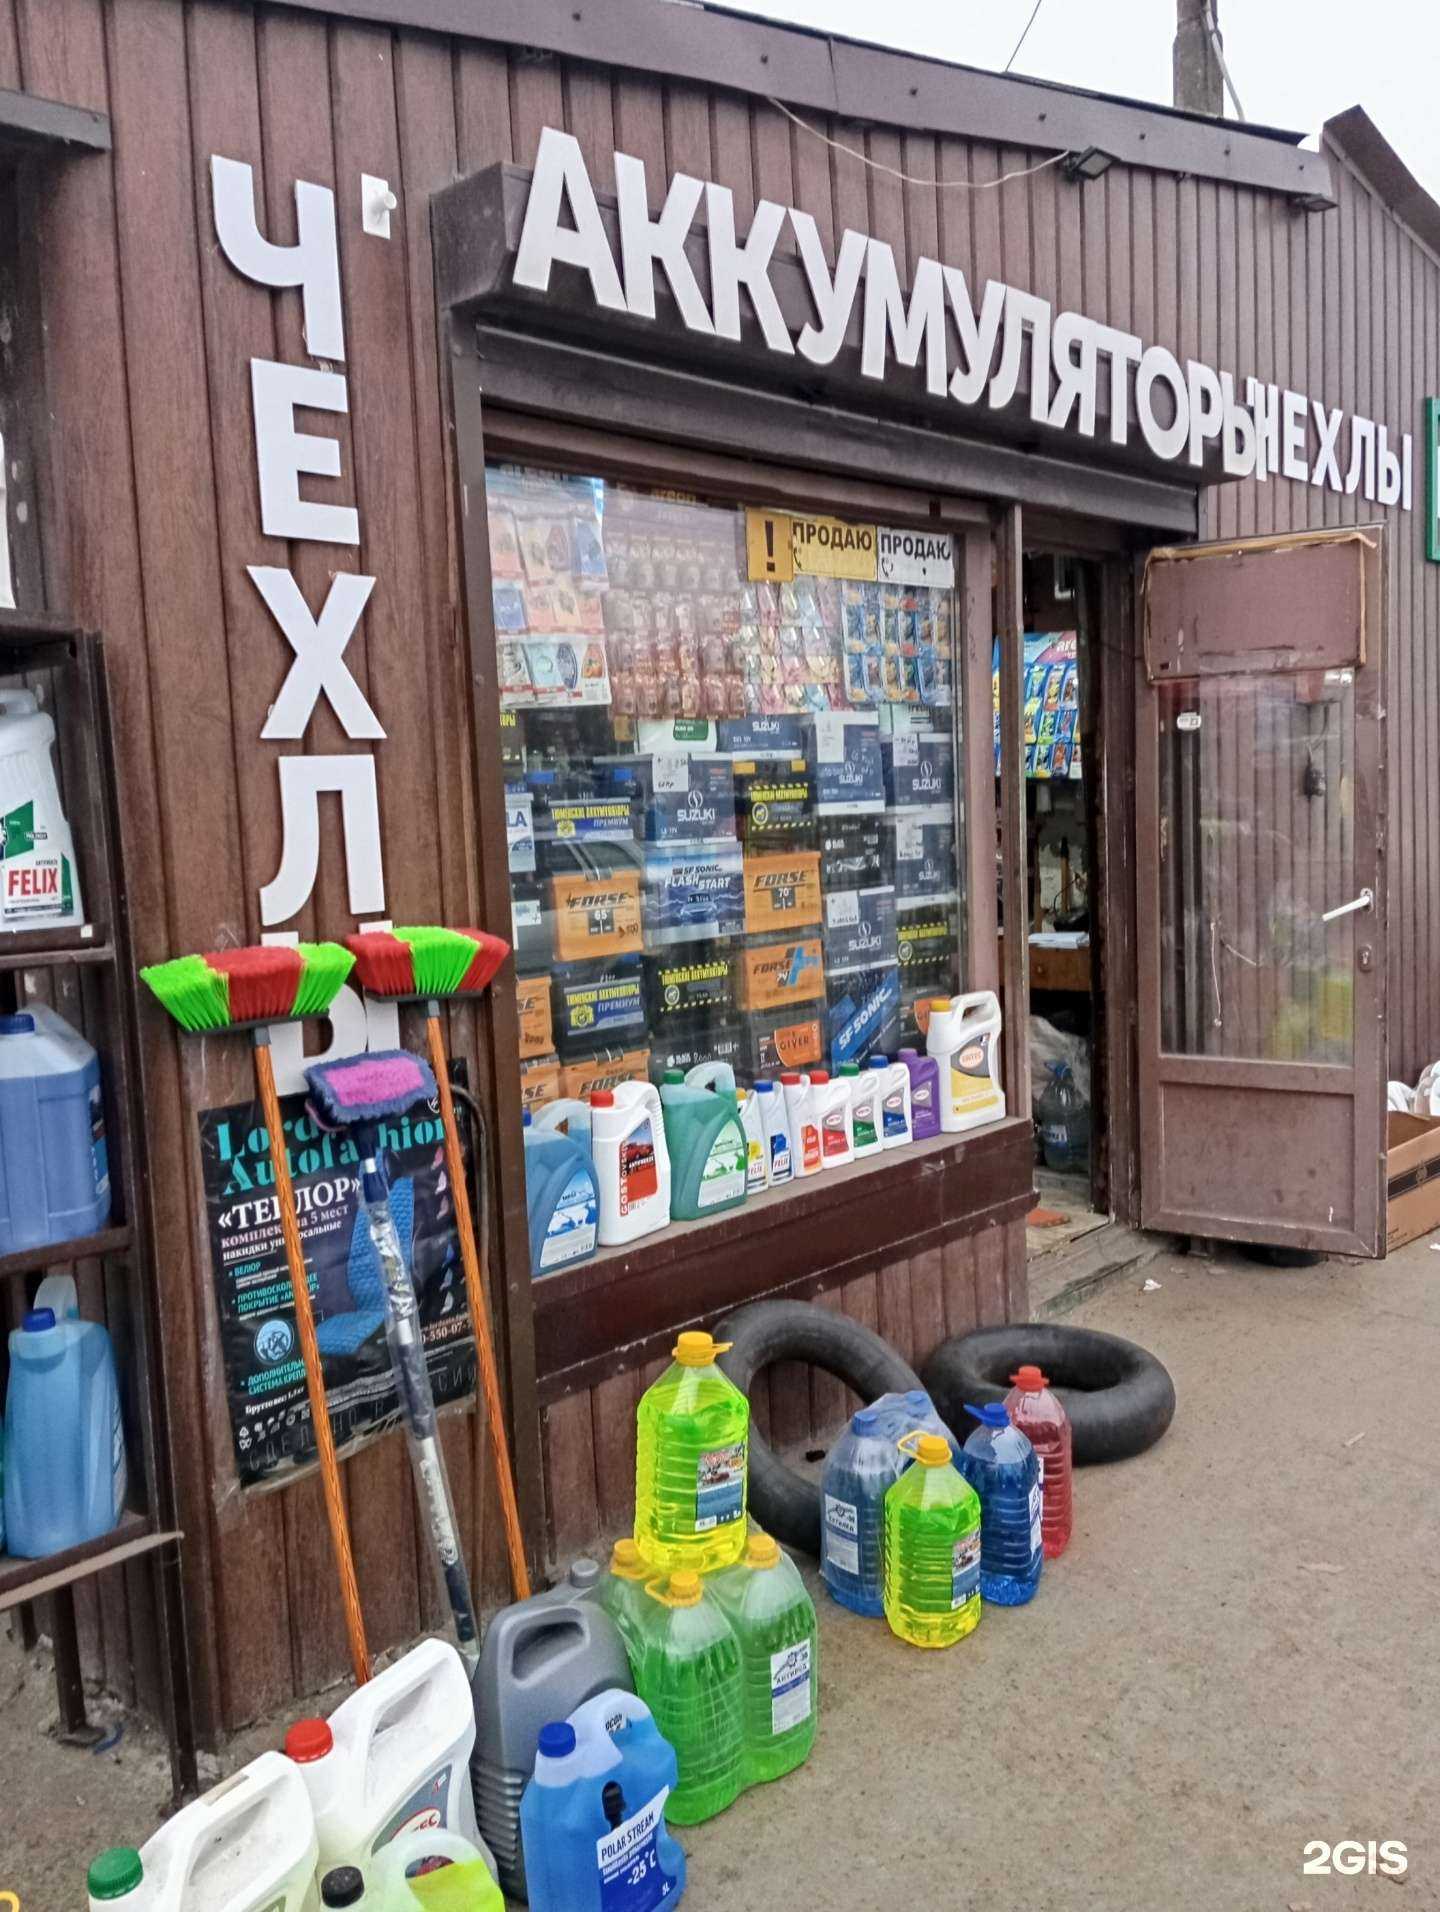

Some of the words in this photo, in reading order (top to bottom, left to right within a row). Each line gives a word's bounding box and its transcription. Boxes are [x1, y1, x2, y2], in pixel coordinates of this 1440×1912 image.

[512, 126, 1267, 482] АККУМУЛЯТОРЫ
[792, 521, 873, 552] ПРОДАЮ
[677, 807, 716, 822] SUZUKI
[8, 867, 58, 896] FELIX
[698, 876, 731, 890] START
[778, 887, 790, 898] 70
[594, 909, 608, 921] 65
[848, 935, 882, 952] SUZUKI
[597, 996, 640, 1012] ПРЕМИУМ
[853, 987, 893, 1035] SONIC
[221, 1223, 285, 1250] комплек
[310, 1211, 319, 1225] 5
[320, 1204, 350, 1222] мест
[222, 1243, 269, 1261] накидки
[601, 1832, 627, 1861] POLAR
[626, 1811, 655, 1844] STREAM
